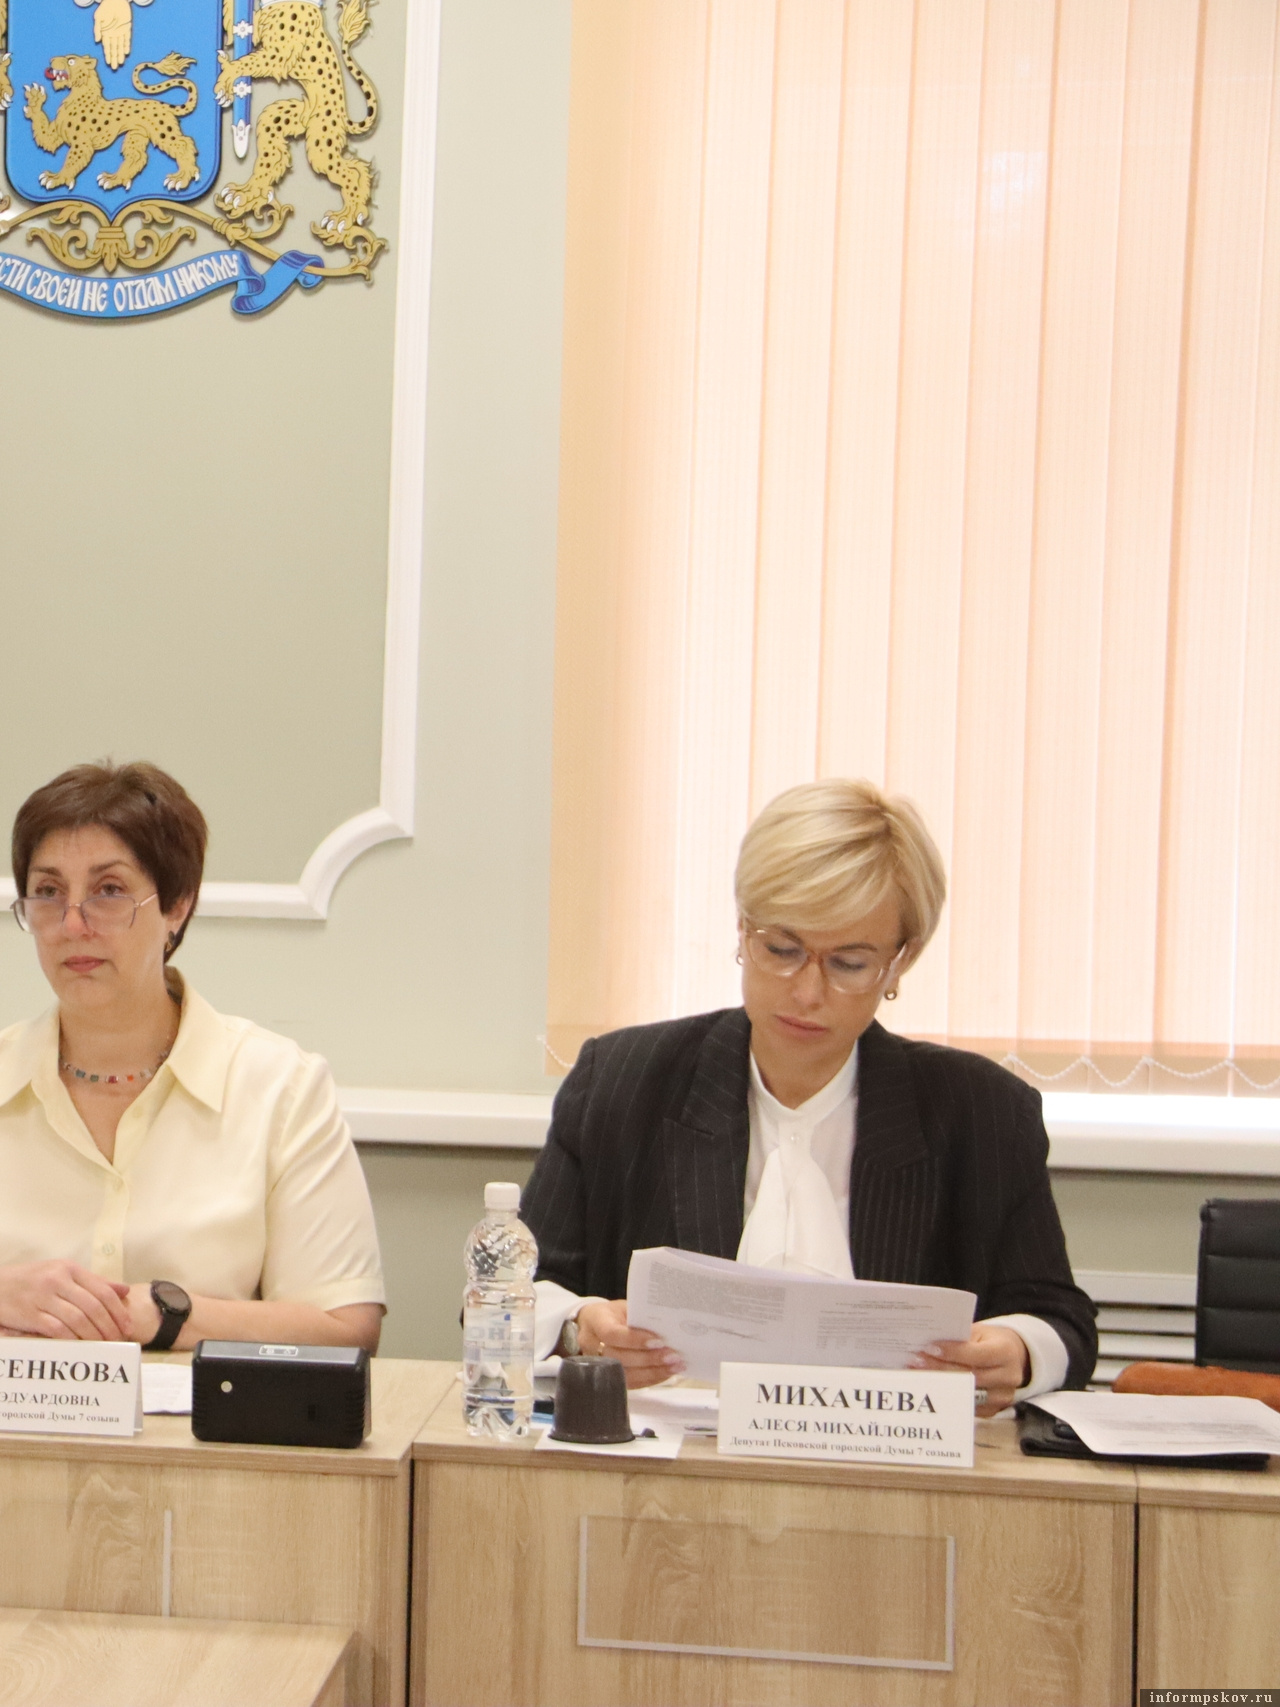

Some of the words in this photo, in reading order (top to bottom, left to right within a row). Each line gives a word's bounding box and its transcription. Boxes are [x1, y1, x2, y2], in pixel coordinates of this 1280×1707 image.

[85, 280, 108, 312] НЕ
[113, 274, 176, 312] ОТДАМ
[172, 254, 238, 297] НИКОМУ
[0, 1391, 101, 1407] ЭДУАРДОВНА
[756, 1383, 937, 1414] МИХАЧЕВА
[48, 1410, 76, 1422] Думы
[78, 1412, 85, 1421] 7
[86, 1415, 120, 1424] созыва
[748, 1418, 808, 1432] АЛЕСЯ
[813, 1420, 943, 1441] МИХАЙЛОВНА
[729, 1436, 771, 1448] Депутат
[773, 1438, 828, 1450] Псковской
[830, 1443, 882, 1453] городской
[884, 1444, 914, 1456] Думы
[925, 1450, 961, 1459] созыва
